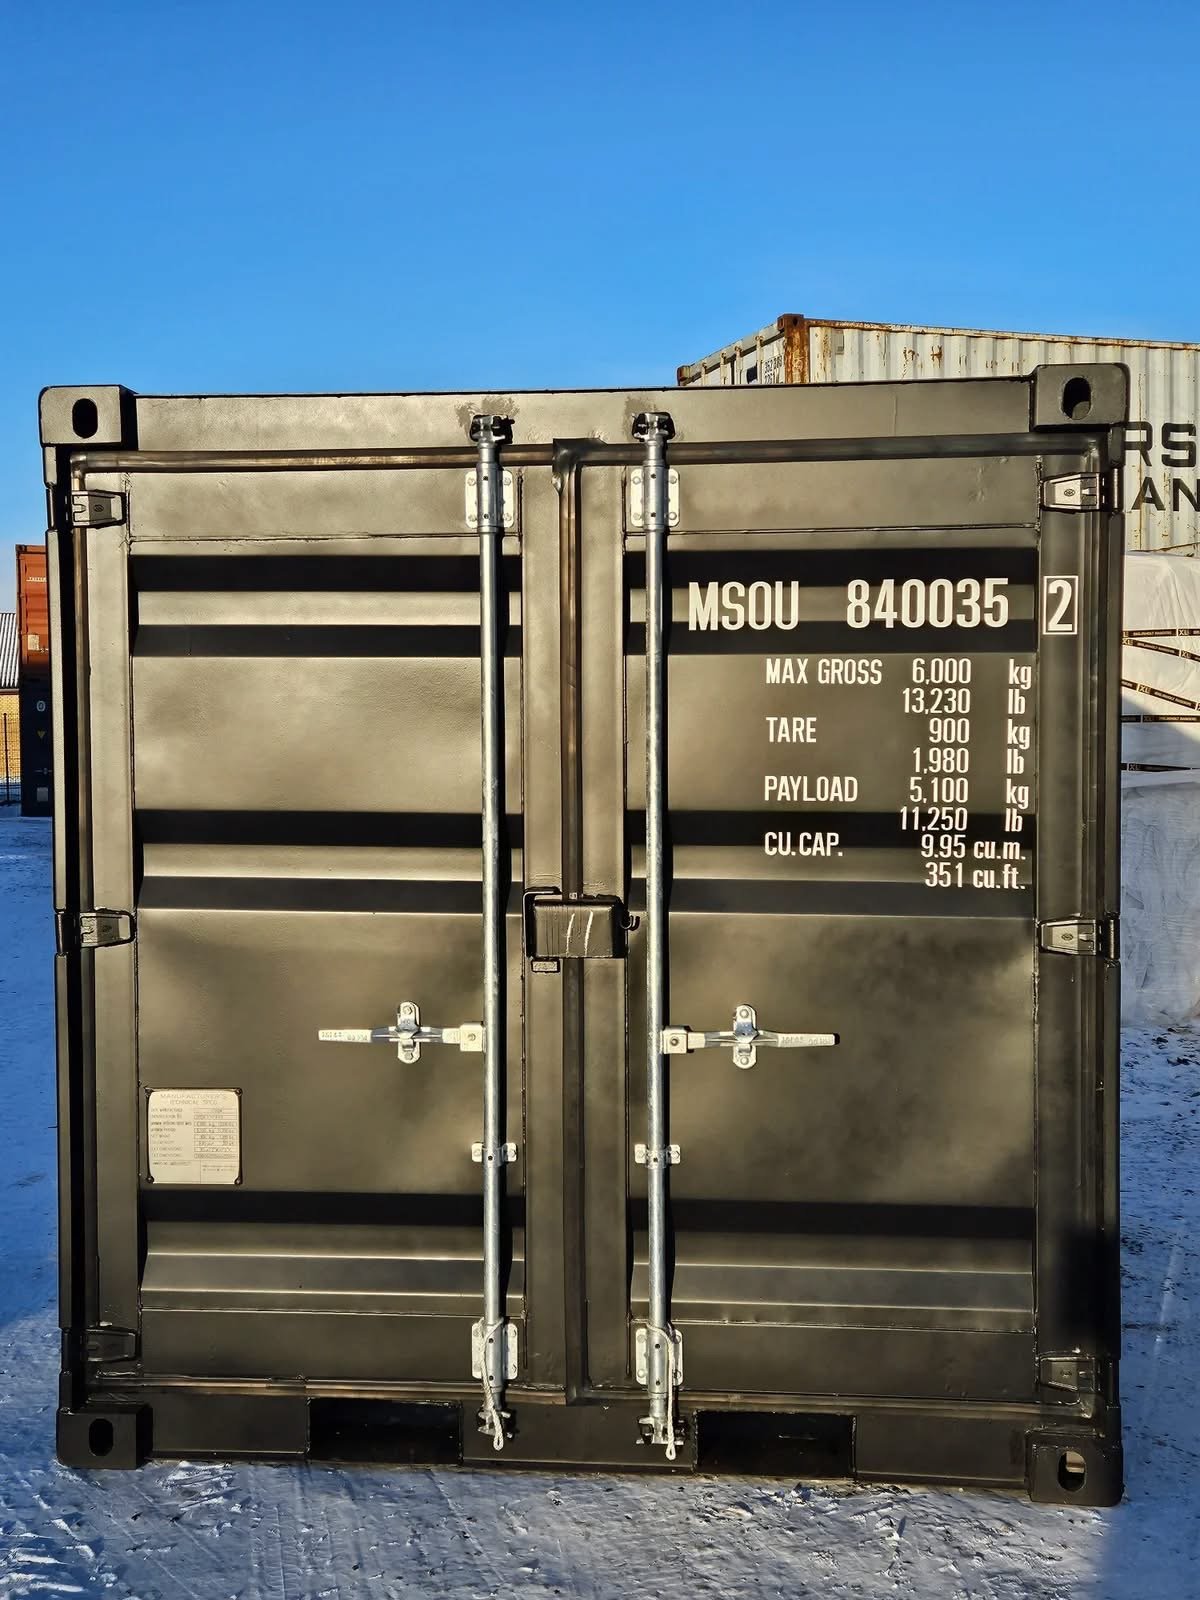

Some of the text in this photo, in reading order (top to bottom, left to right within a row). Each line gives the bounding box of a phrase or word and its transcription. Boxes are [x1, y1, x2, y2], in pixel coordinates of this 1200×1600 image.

[1123, 421, 1197, 468] RS
[1131, 477, 1200, 512] AN
[688, 578, 1073, 631] MSOU 840035 2
[766, 658, 1032, 690] MAX GROSS 6,000 kg
[902, 688, 1026, 715] 13,230 lb
[765, 717, 1031, 750] TARE 900 kg
[912, 747, 1025, 774] 1,980 lb
[764, 775, 1029, 810] PAYLOAD 5,100 kg
[1005, 808, 1024, 832] lb
[921, 834, 966, 858] 9.95
[973, 840, 1026, 860] cu.m.
[925, 861, 1026, 889] 351 cu.ft.
